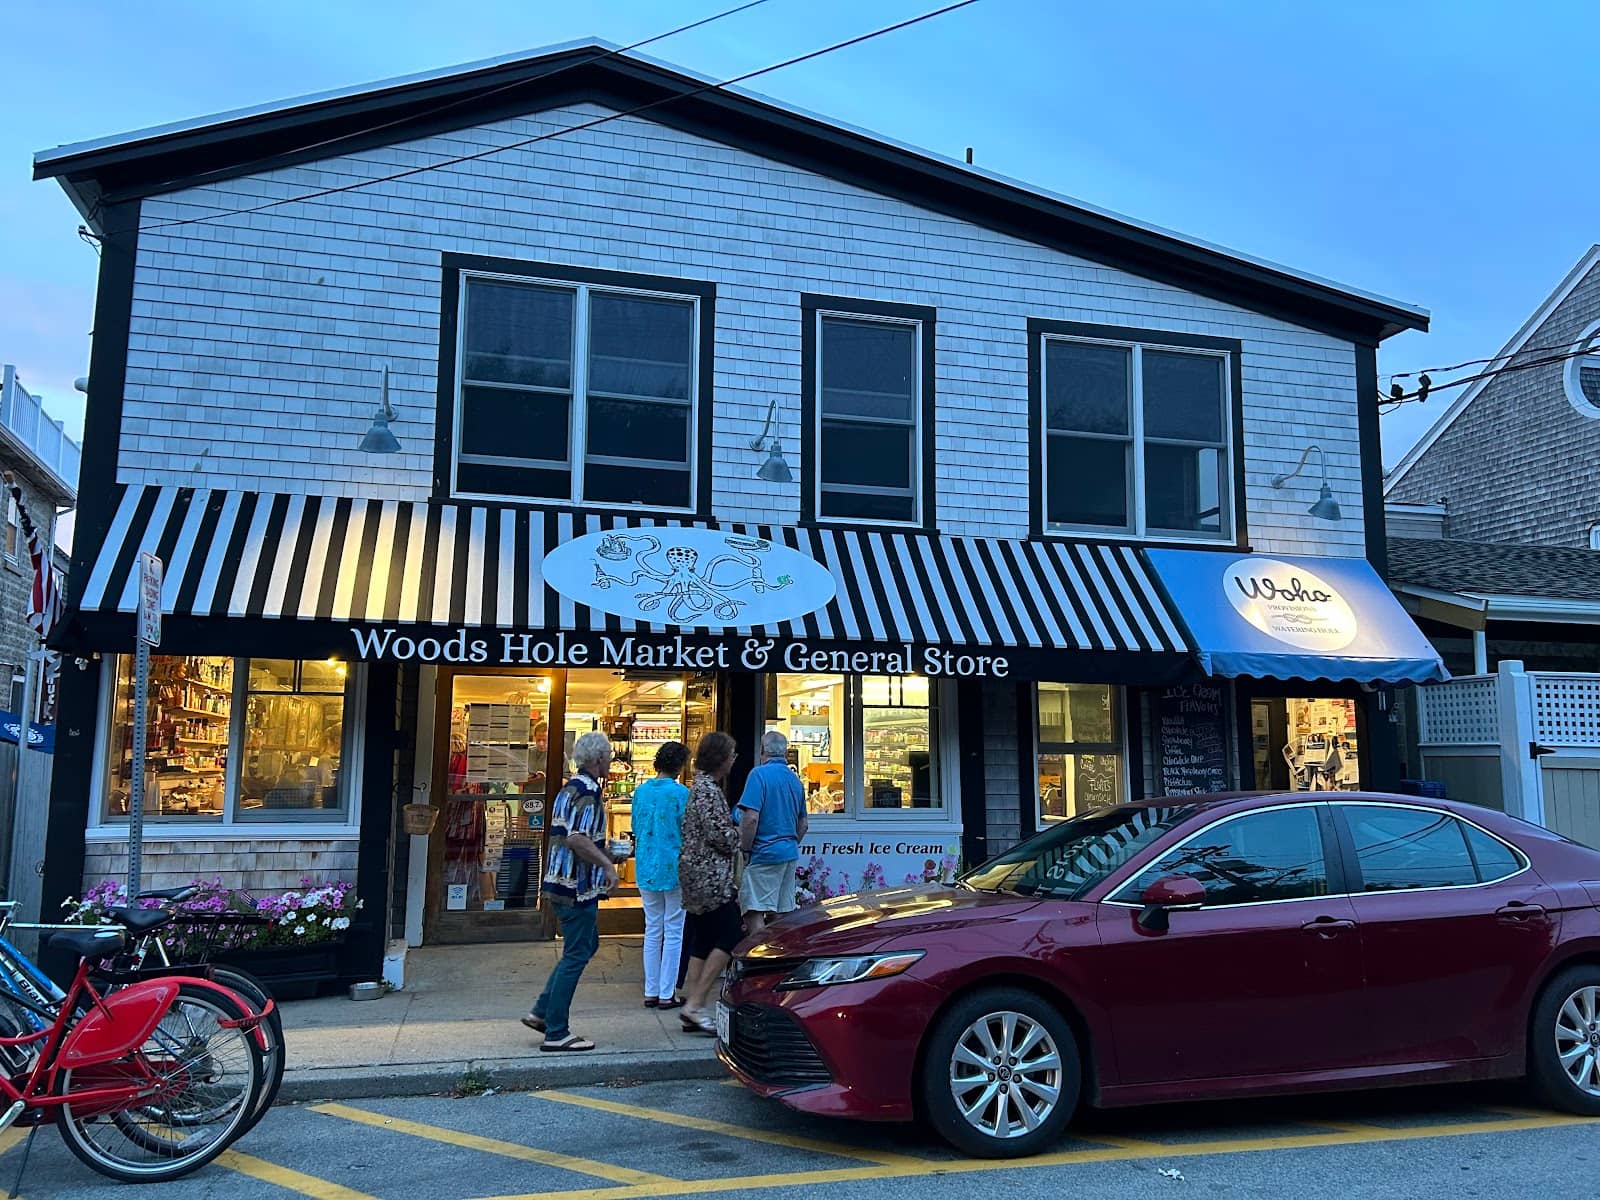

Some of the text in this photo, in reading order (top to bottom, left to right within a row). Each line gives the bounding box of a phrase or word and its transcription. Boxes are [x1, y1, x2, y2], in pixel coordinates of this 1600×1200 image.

[1234, 577, 1331, 602] Woho
[351, 628, 1009, 677] Woods Hole Market & General Store
[822, 842, 863, 854] Fresh
[870, 843, 891, 854] Ice
[896, 843, 943, 854] Cream
